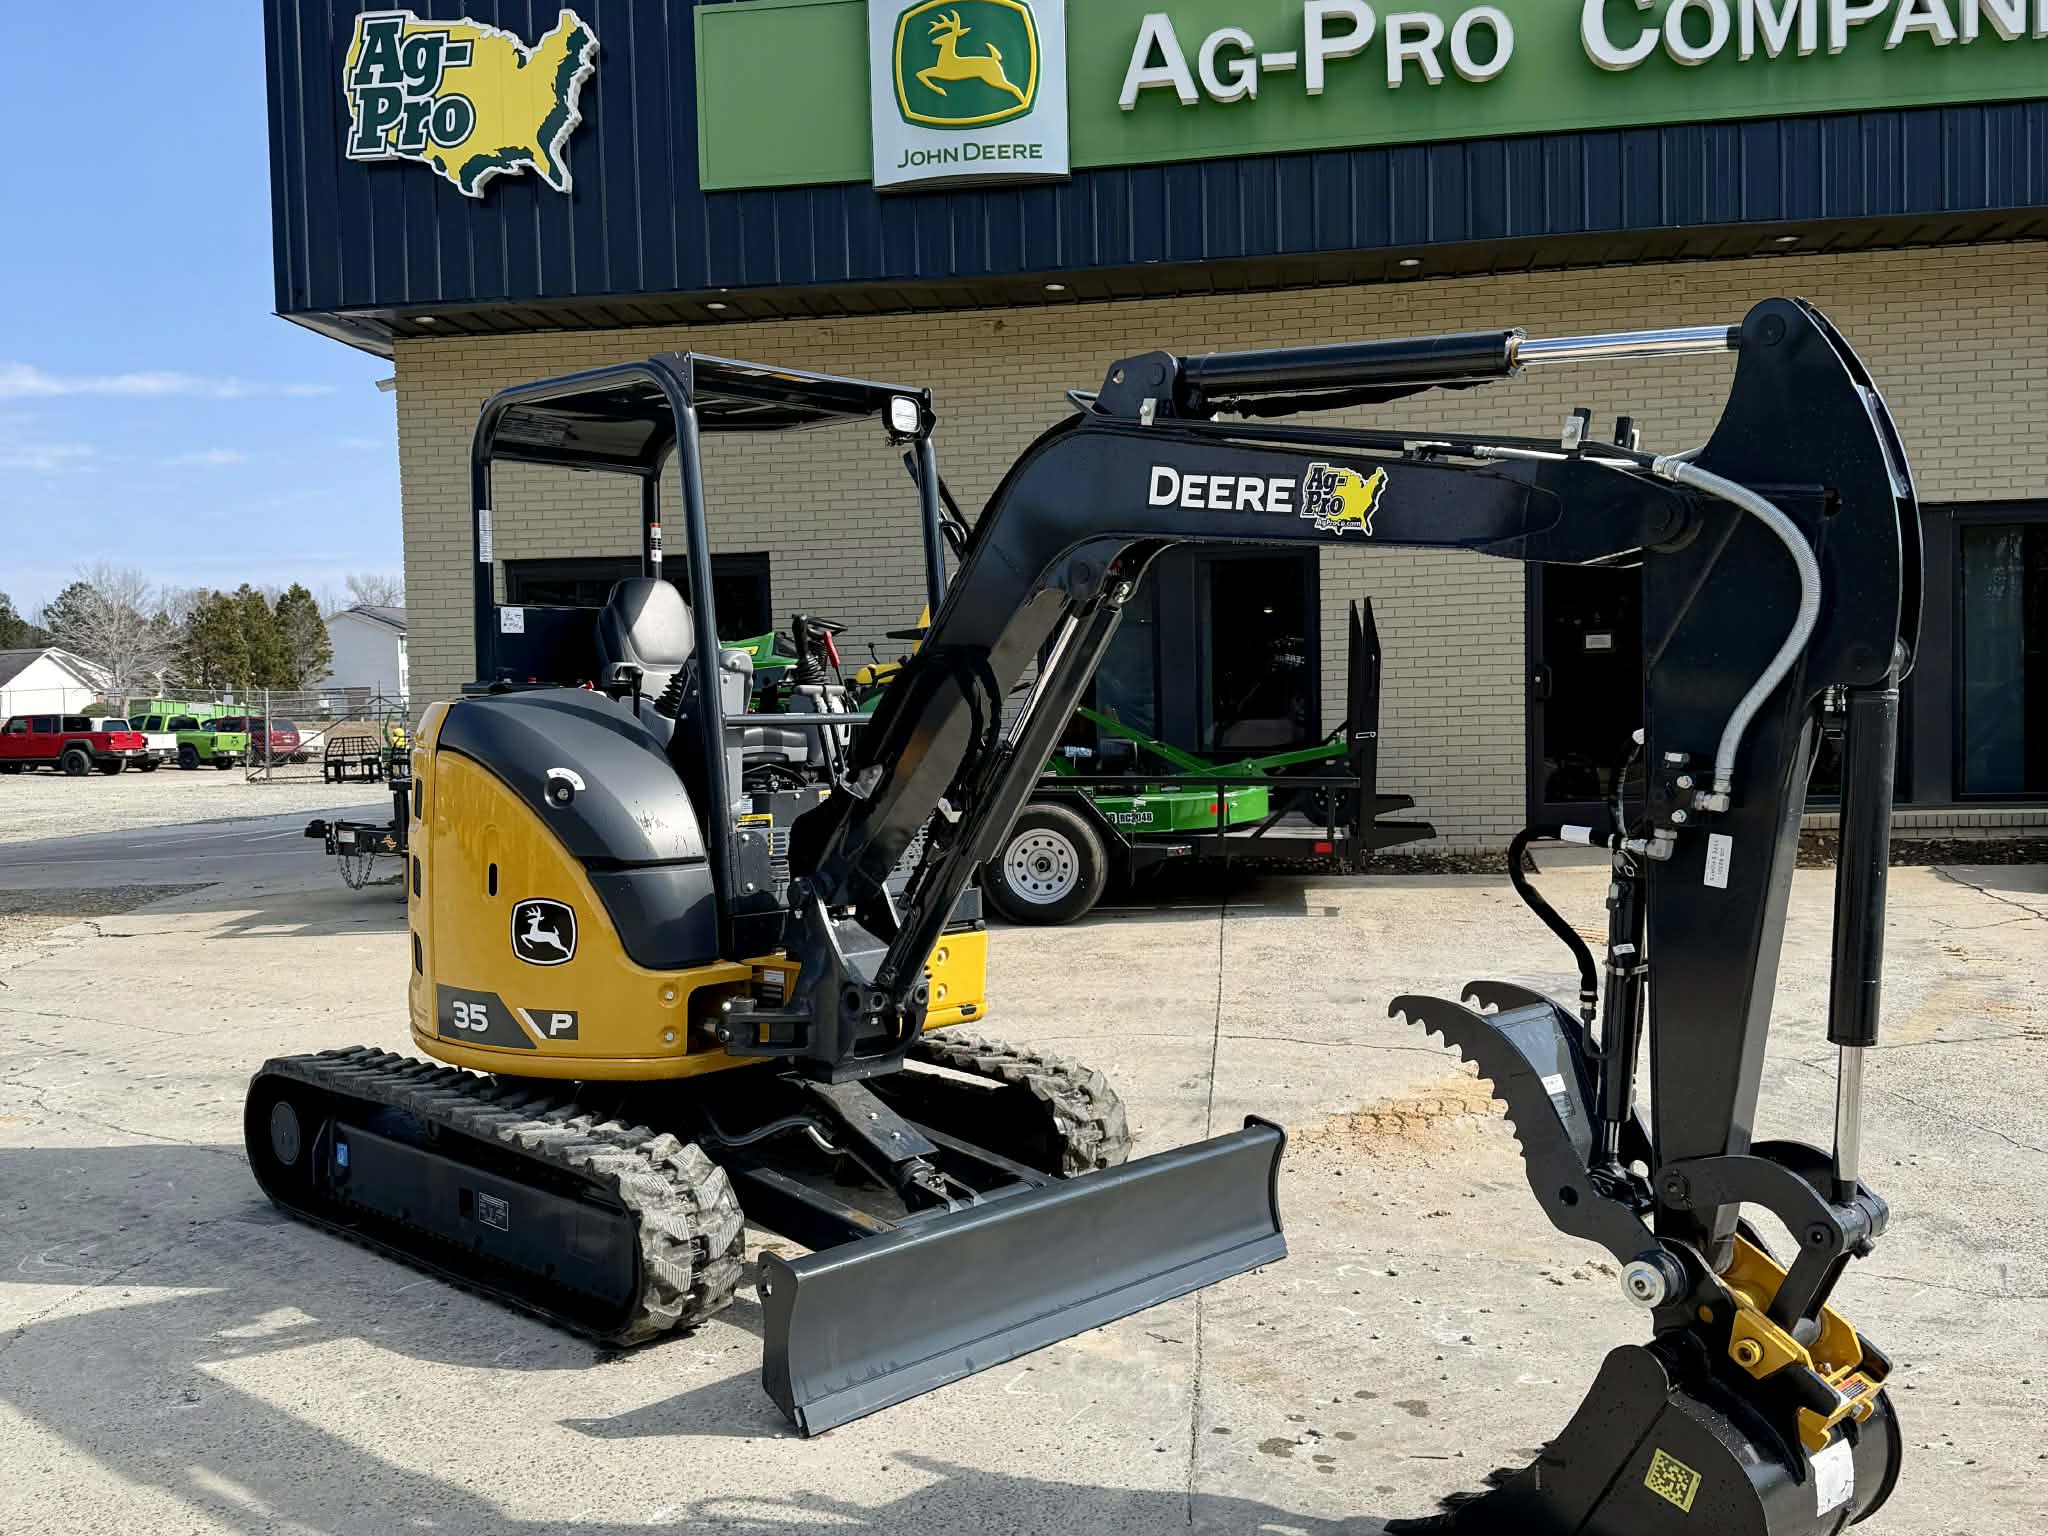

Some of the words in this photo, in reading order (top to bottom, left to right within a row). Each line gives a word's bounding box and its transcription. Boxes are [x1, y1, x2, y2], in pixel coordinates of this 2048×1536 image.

[352, 16, 473, 97] Ag-
[1580, 0, 2048, 71] COMPAN
[352, 87, 474, 153] Pro
[897, 146, 959, 169] JOHN
[963, 142, 1043, 162] DEERE
[1148, 465, 1296, 513] DEERE
[1306, 464, 1347, 494] Ag-
[1303, 490, 1345, 515] Pro
[452, 1000, 489, 1033] 35
[549, 1013, 573, 1036] P
